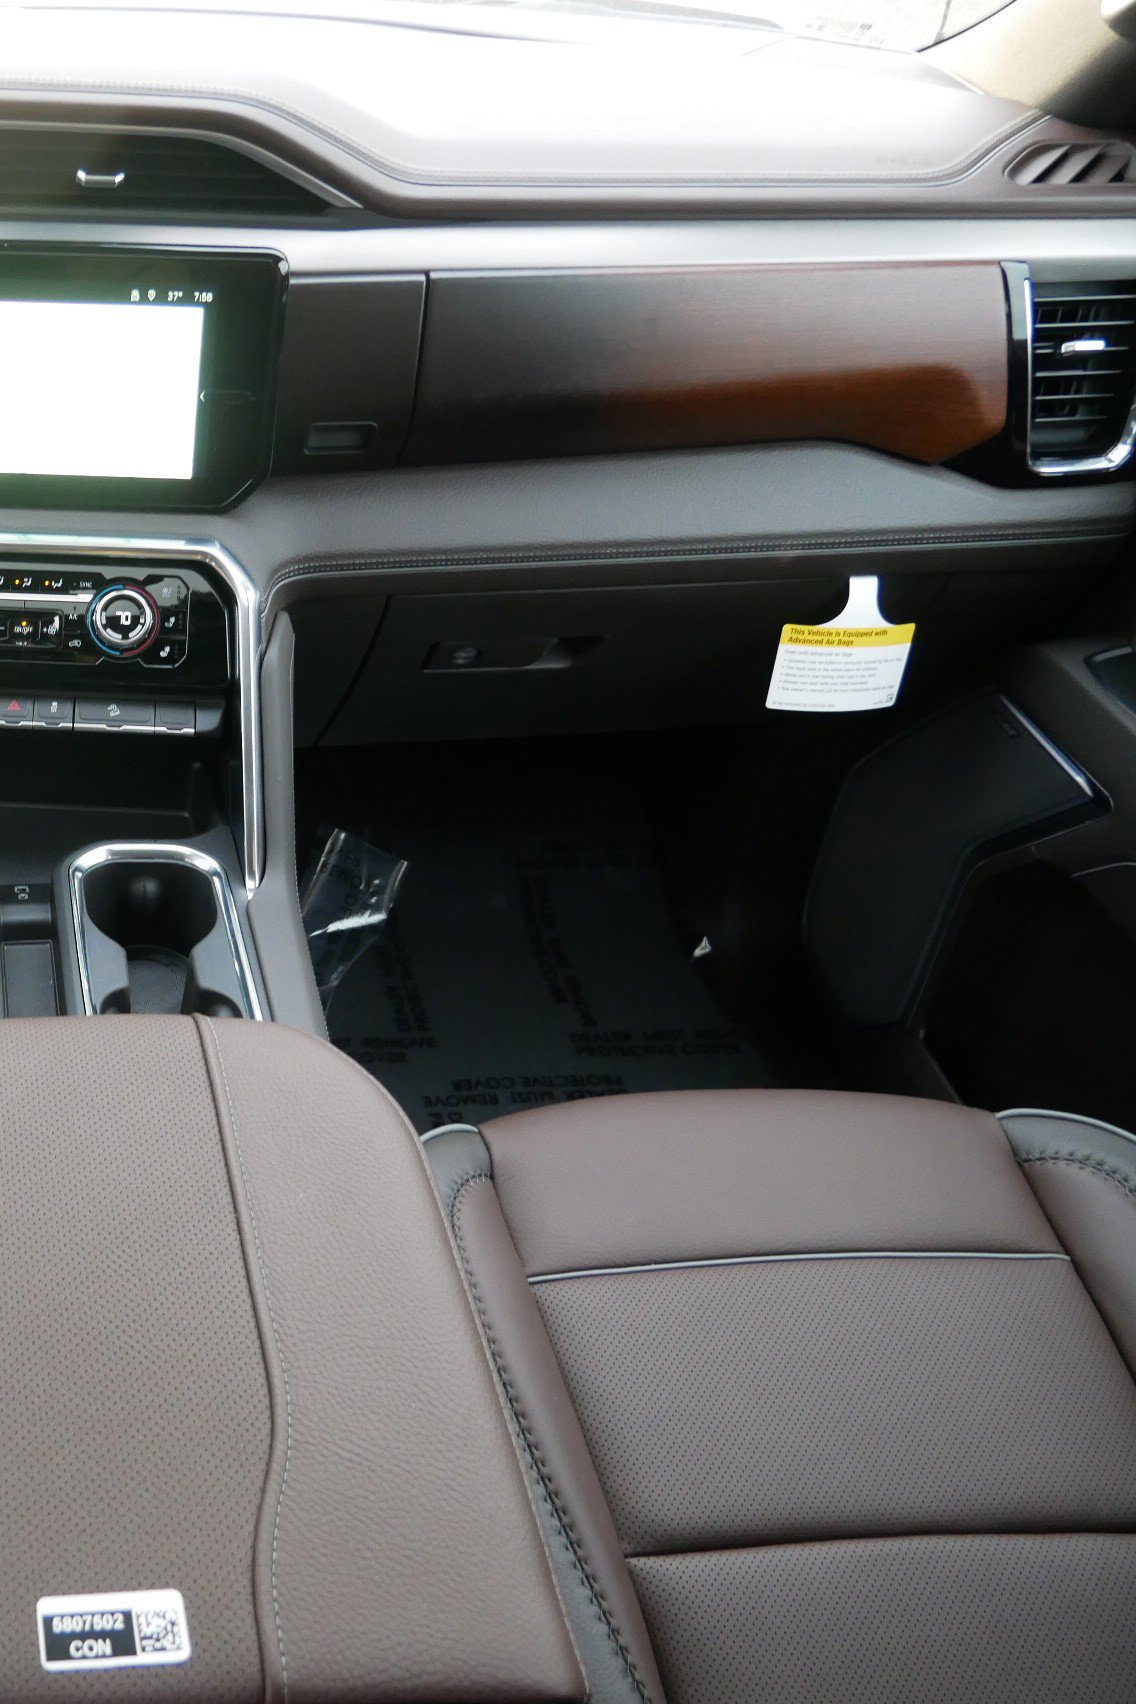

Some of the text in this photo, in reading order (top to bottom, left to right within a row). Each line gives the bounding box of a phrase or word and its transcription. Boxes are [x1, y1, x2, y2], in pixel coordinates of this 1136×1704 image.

[116, 611, 132, 625] 70
[790, 627, 888, 640] This Vehicle is Equipped with
[788, 636, 854, 647] Advanced Air Bags
[451, 1073, 625, 1093] PROTECTIVE COVER
[422, 1093, 500, 1109] REMOVE
[69, 1638, 113, 1659] CON
